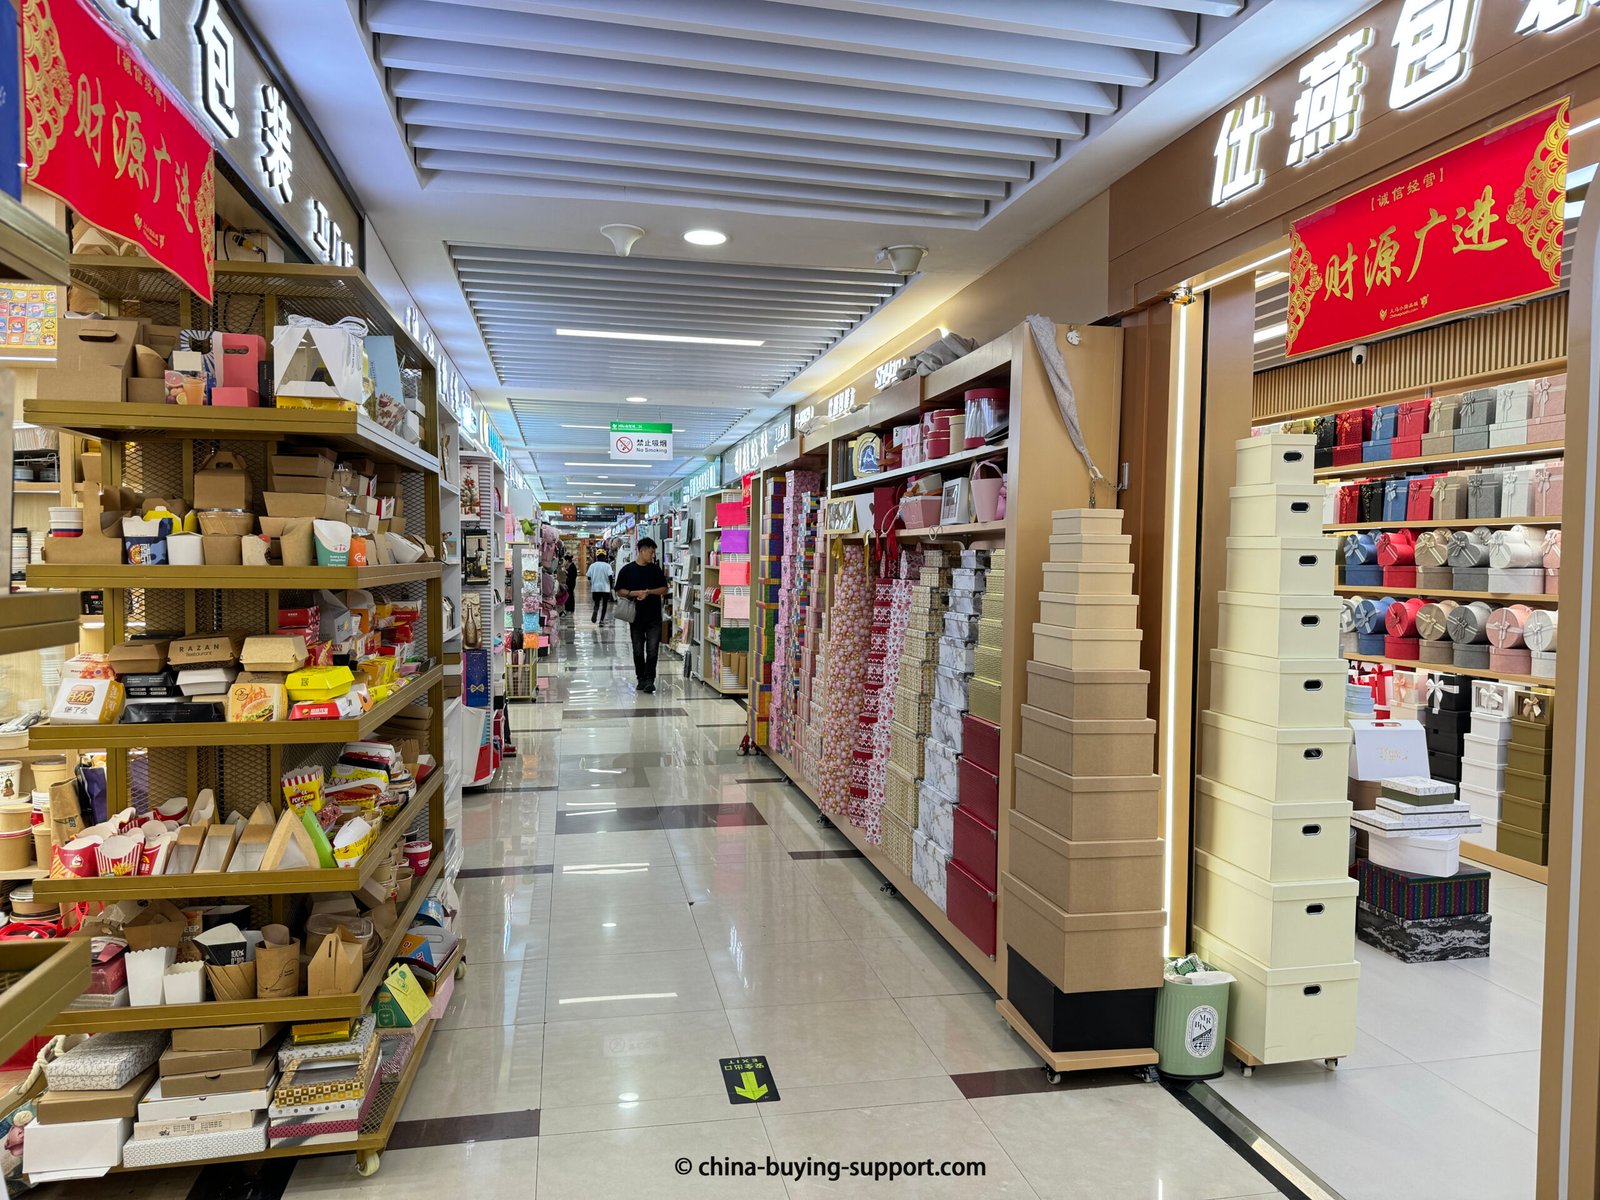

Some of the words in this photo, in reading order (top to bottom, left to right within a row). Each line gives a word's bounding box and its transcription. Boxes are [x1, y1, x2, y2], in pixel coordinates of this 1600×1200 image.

[74, 72, 194, 235] 财源广进
[1324, 184, 1508, 302] 财源广进
[636, 439, 667, 447] 禁止吸烟
[179, 644, 219, 652] RAZAN
[724, 1062, 765, 1071] 安全出口
